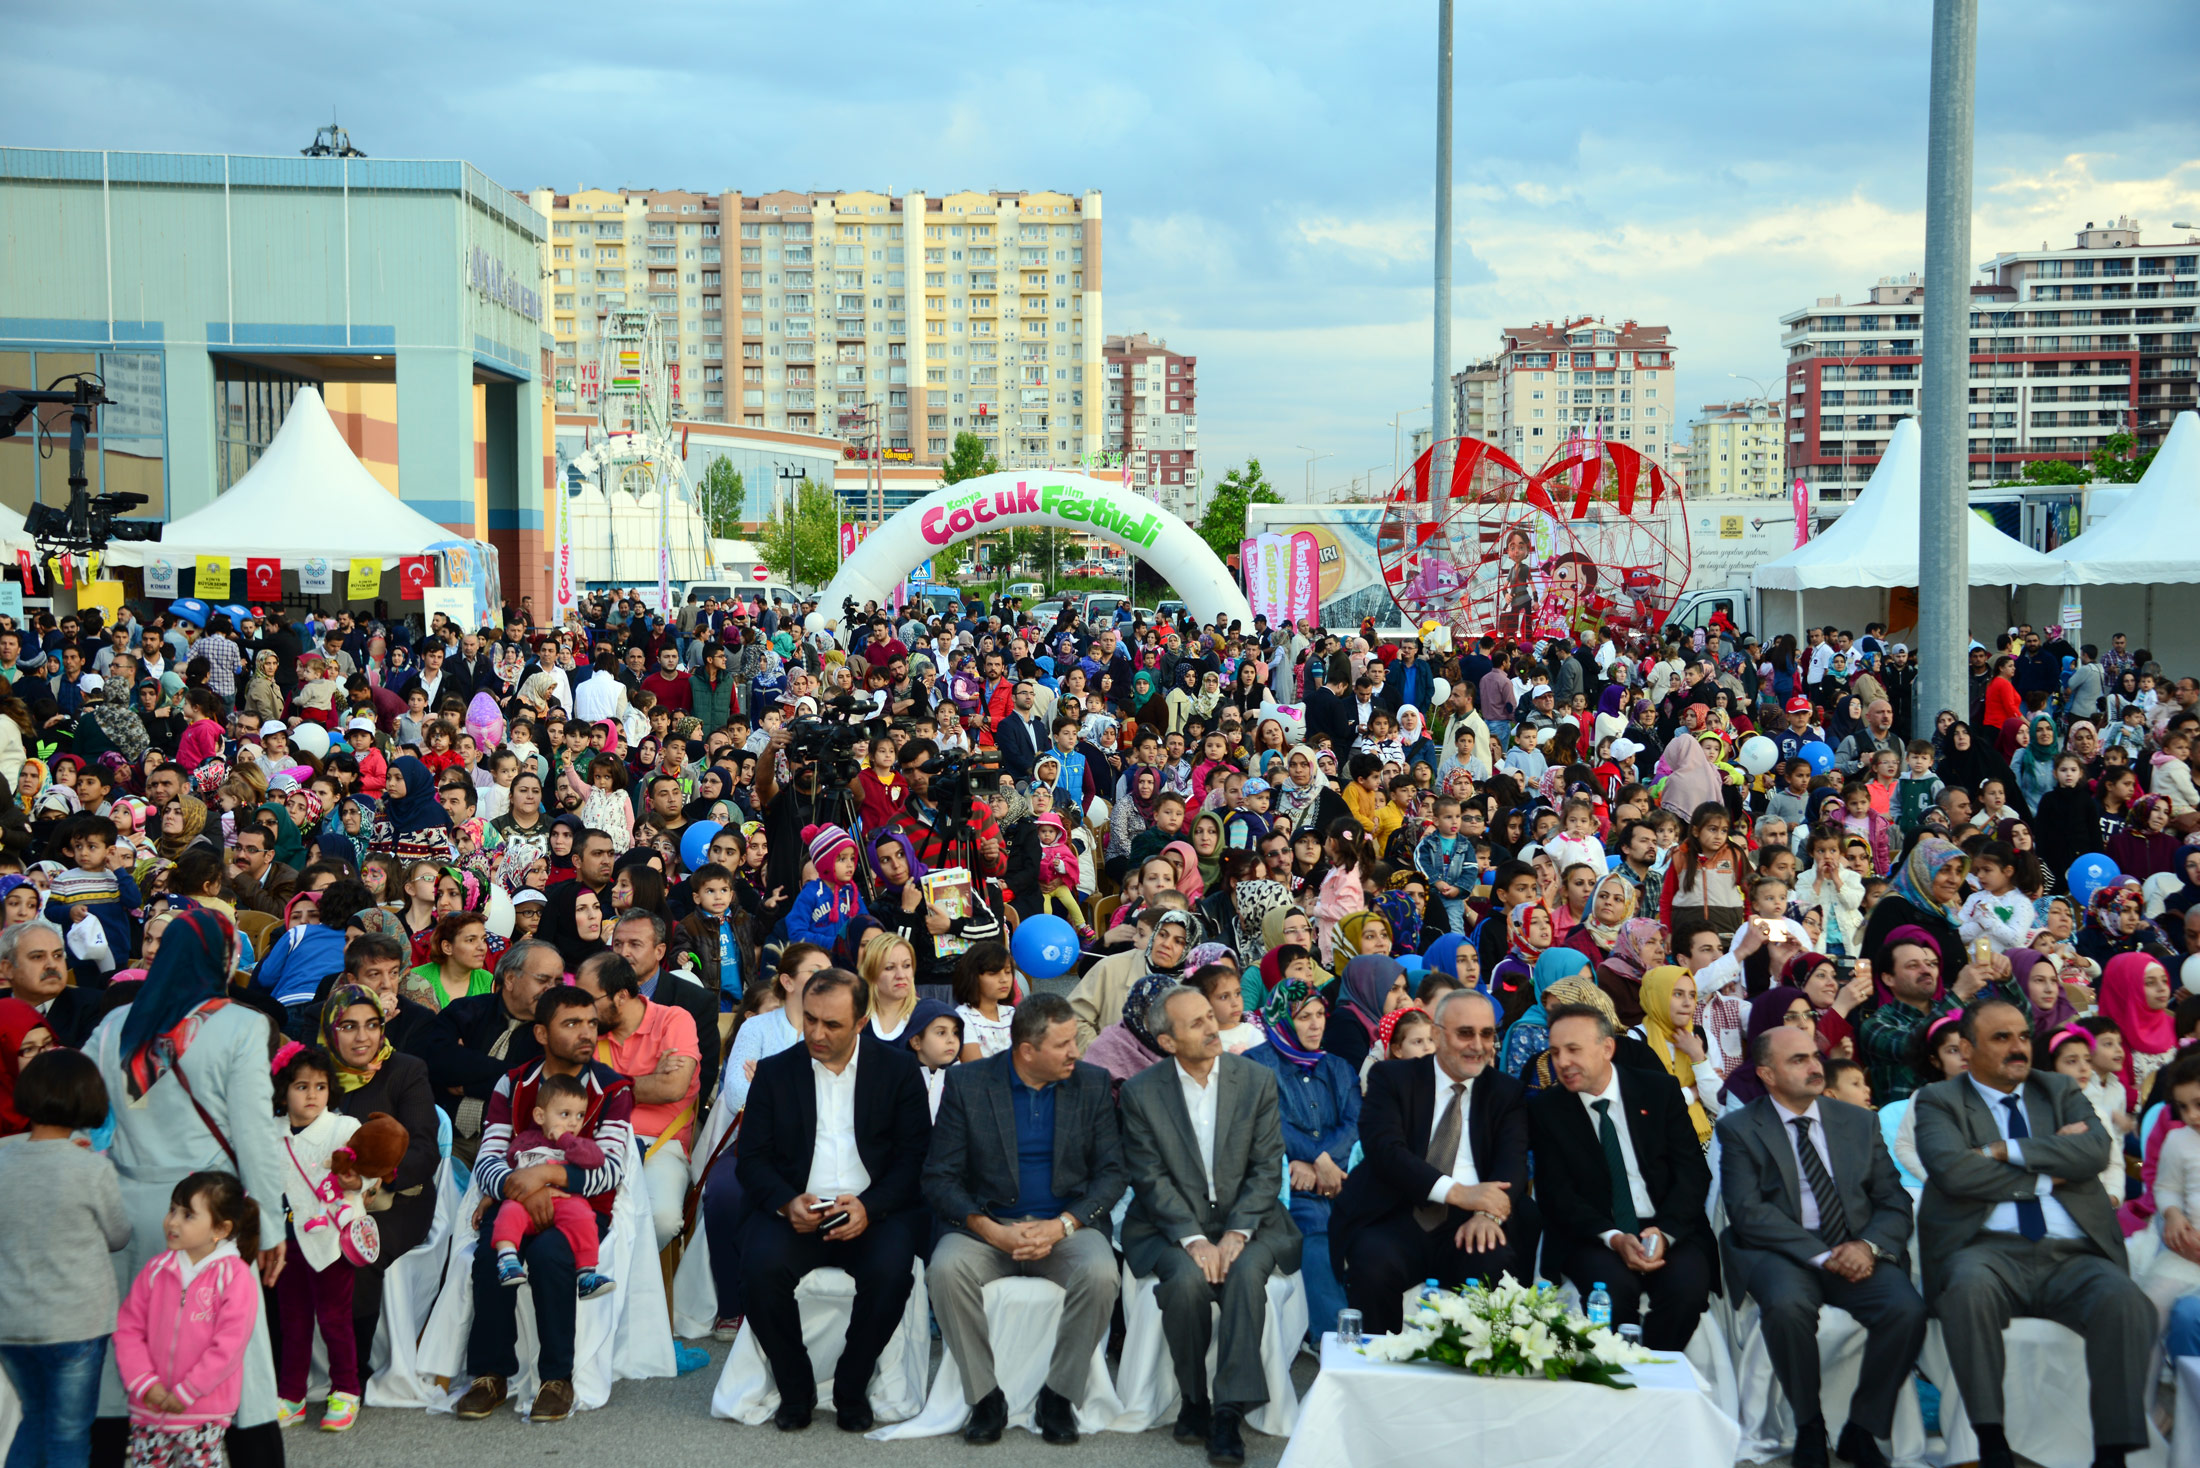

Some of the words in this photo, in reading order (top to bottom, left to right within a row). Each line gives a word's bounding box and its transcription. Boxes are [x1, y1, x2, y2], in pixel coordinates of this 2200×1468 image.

[921, 481, 1040, 546] Çocuk
[1041, 485, 1164, 550] Festivali
[946, 491, 982, 511] Konya
[1319, 545, 1338, 563] IRI
[558, 545, 572, 605] Çocuk
